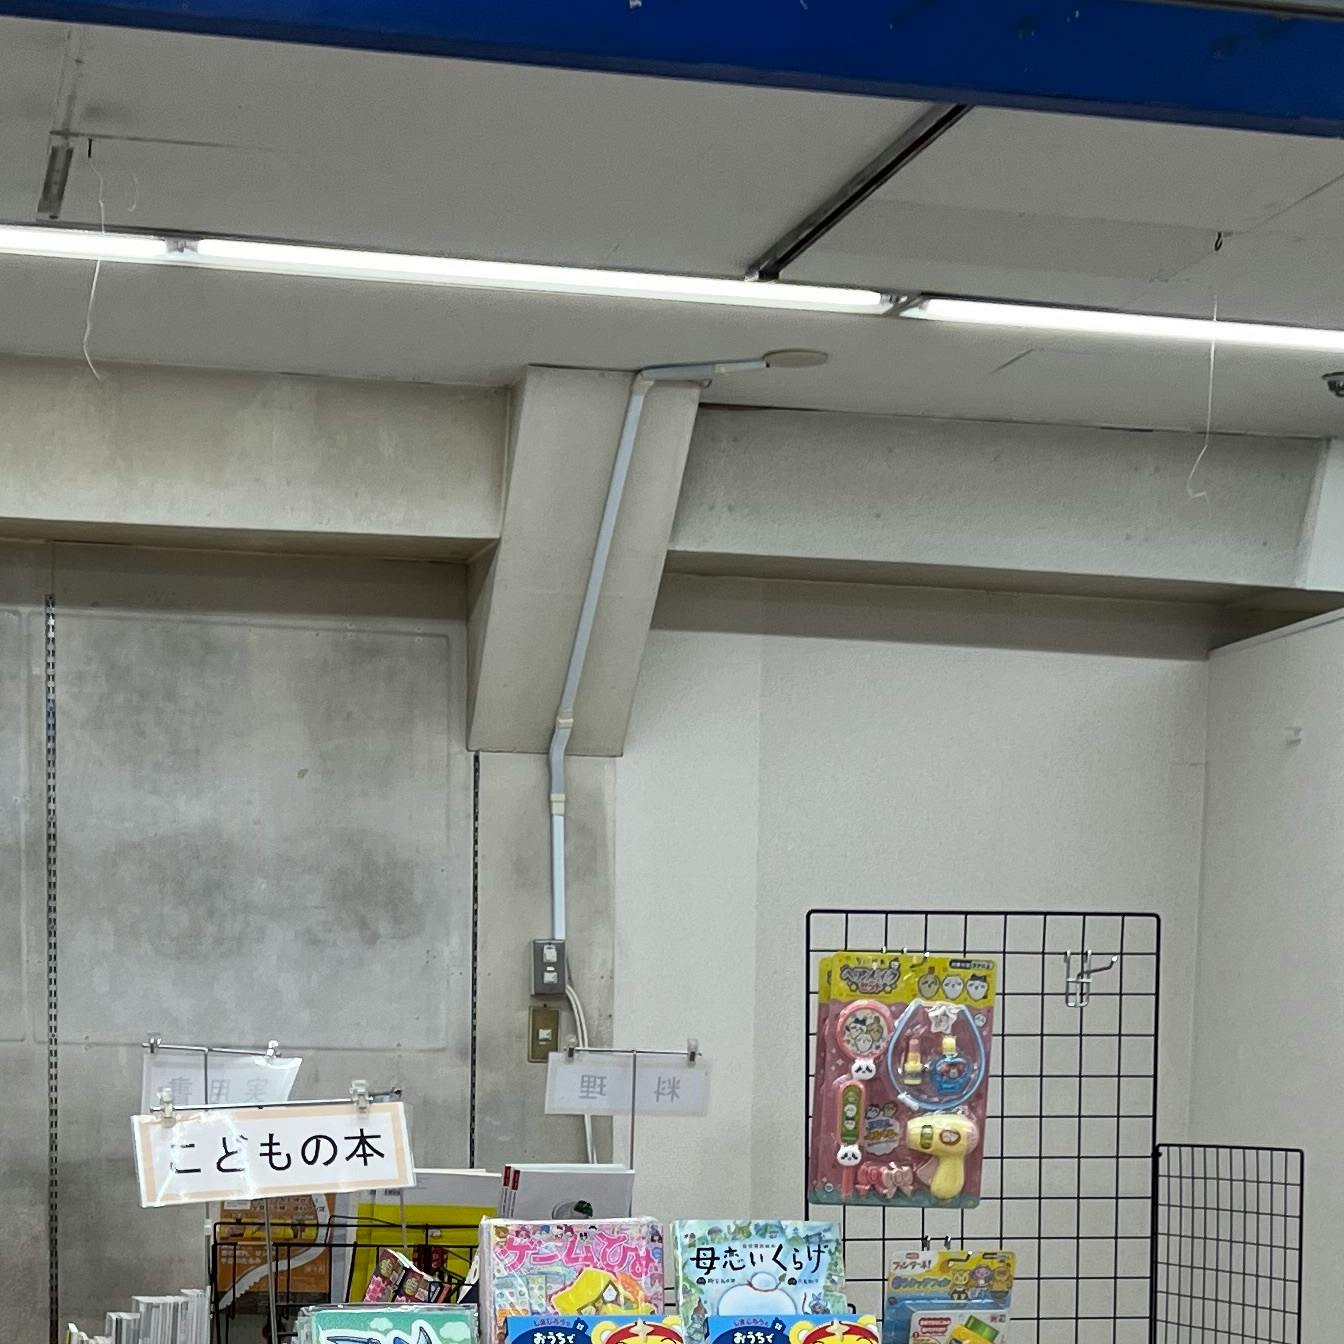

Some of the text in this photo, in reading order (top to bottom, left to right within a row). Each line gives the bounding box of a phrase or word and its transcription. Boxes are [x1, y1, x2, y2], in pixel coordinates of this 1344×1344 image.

[169, 1126, 386, 1175] こどもの本
[690, 1243, 829, 1276] 母恋いくらげ
[732, 1331, 774, 1344] おうちで
